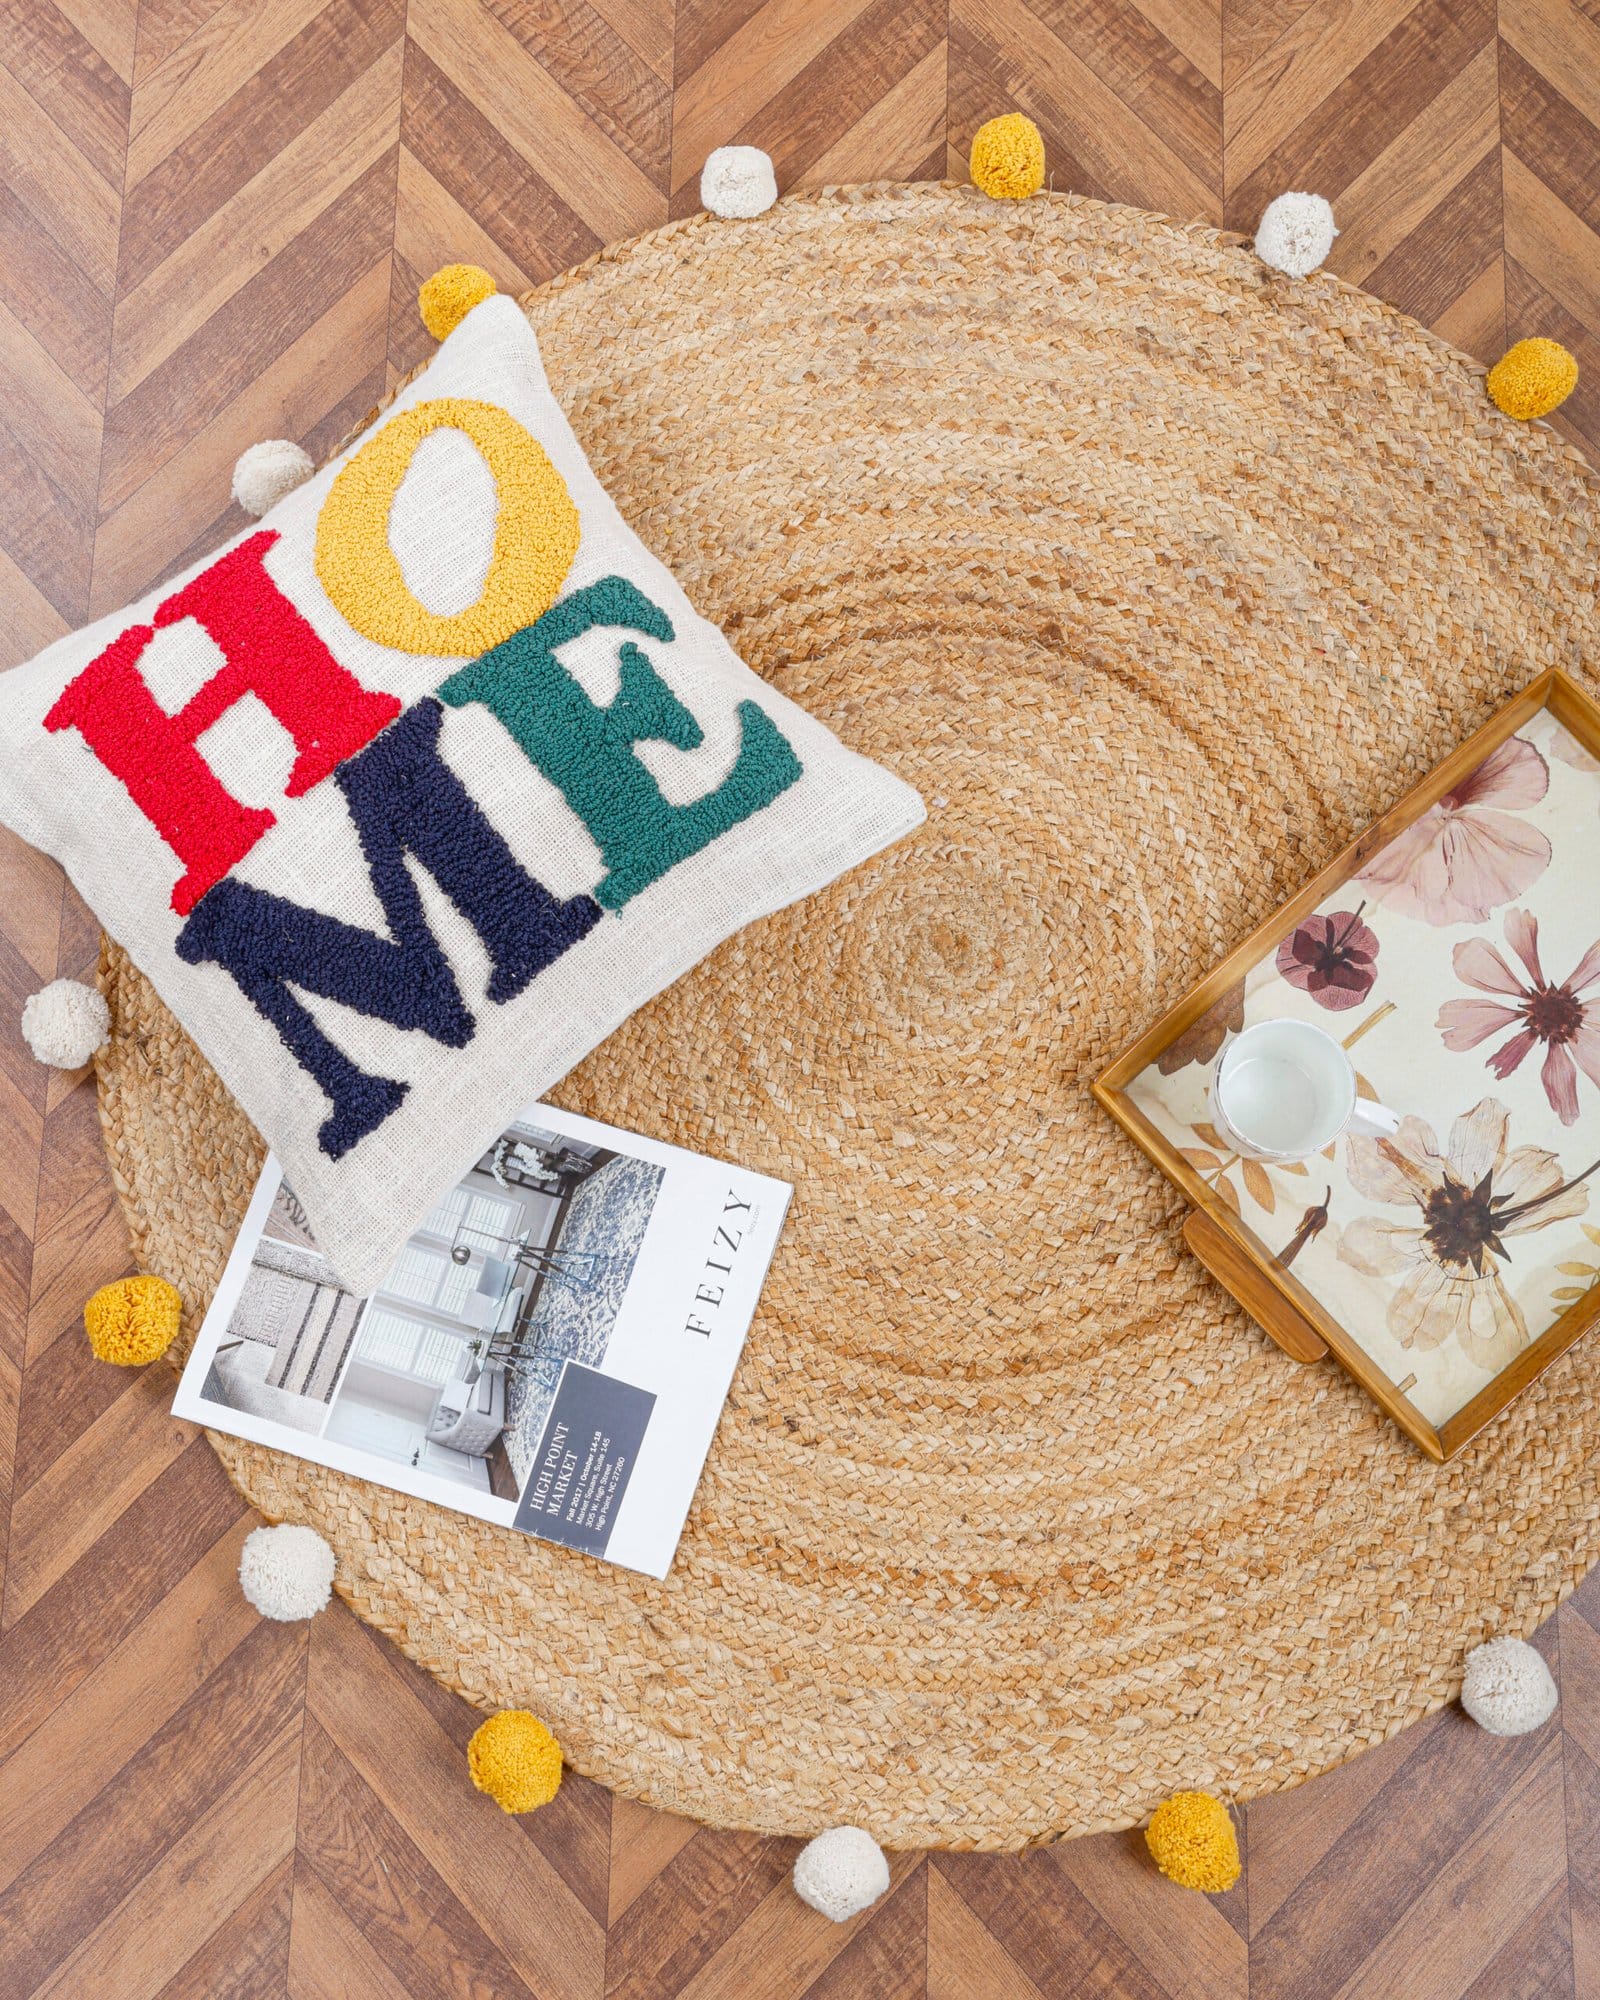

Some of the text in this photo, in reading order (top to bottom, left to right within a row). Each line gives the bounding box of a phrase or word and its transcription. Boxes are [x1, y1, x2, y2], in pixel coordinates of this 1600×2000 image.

[685, 1189, 751, 1339] FEIZY
[530, 1422, 569, 1510] HIGH POINT
[546, 1450, 578, 1516] MARKET
[566, 1507, 576, 1521] Fall
[571, 1487, 583, 1508] 2017
[580, 1453, 594, 1481] October
[589, 1430, 602, 1452] 14-18
[576, 1437, 610, 1524] Market Square, Suite 145
[585, 1463, 612, 1527] 305 W. High Street
[595, 1456, 625, 1531] High Point, NC 27260
